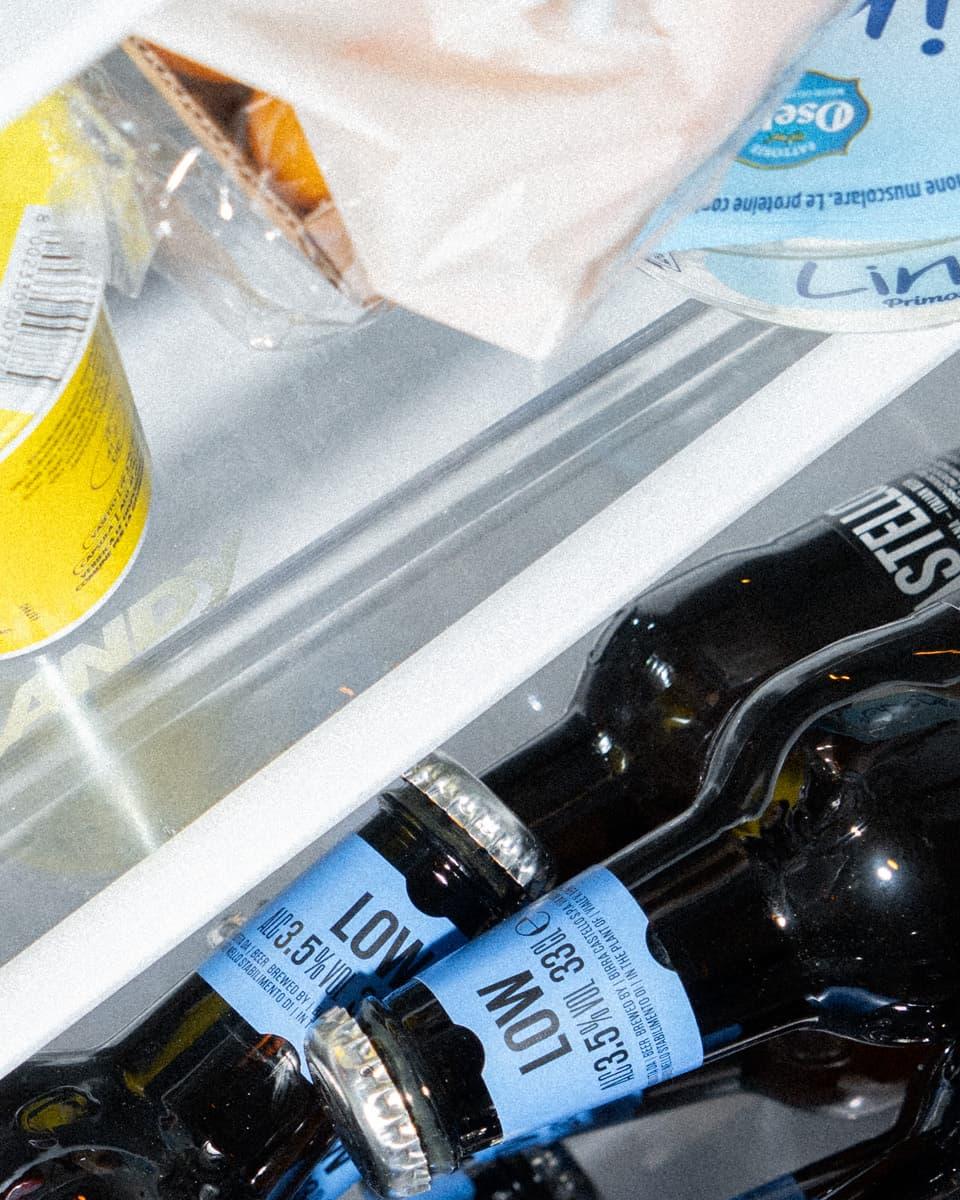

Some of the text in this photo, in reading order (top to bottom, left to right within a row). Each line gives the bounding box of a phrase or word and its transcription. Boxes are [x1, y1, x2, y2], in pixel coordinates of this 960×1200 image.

[733, 191, 802, 216] proteine
[799, 191, 826, 211] Le
[832, 181, 923, 208] muscolare.
[573, 916, 605, 954] CASTELLO
[591, 917, 606, 928] OF
[598, 926, 622, 953] PLANT
[597, 951, 620, 980] BIRRA
[614, 950, 632, 969] THE
[267, 964, 299, 995] BREWED
[295, 990, 310, 1004] BY
[625, 968, 638, 980] IN
[615, 987, 631, 1000] BY
[633, 986, 646, 998] DI
[476, 969, 572, 1075] LOW
[623, 1000, 647, 1037] BREWED
[638, 997, 669, 1054] STABILIMENTO
[638, 1037, 654, 1058] BEER
